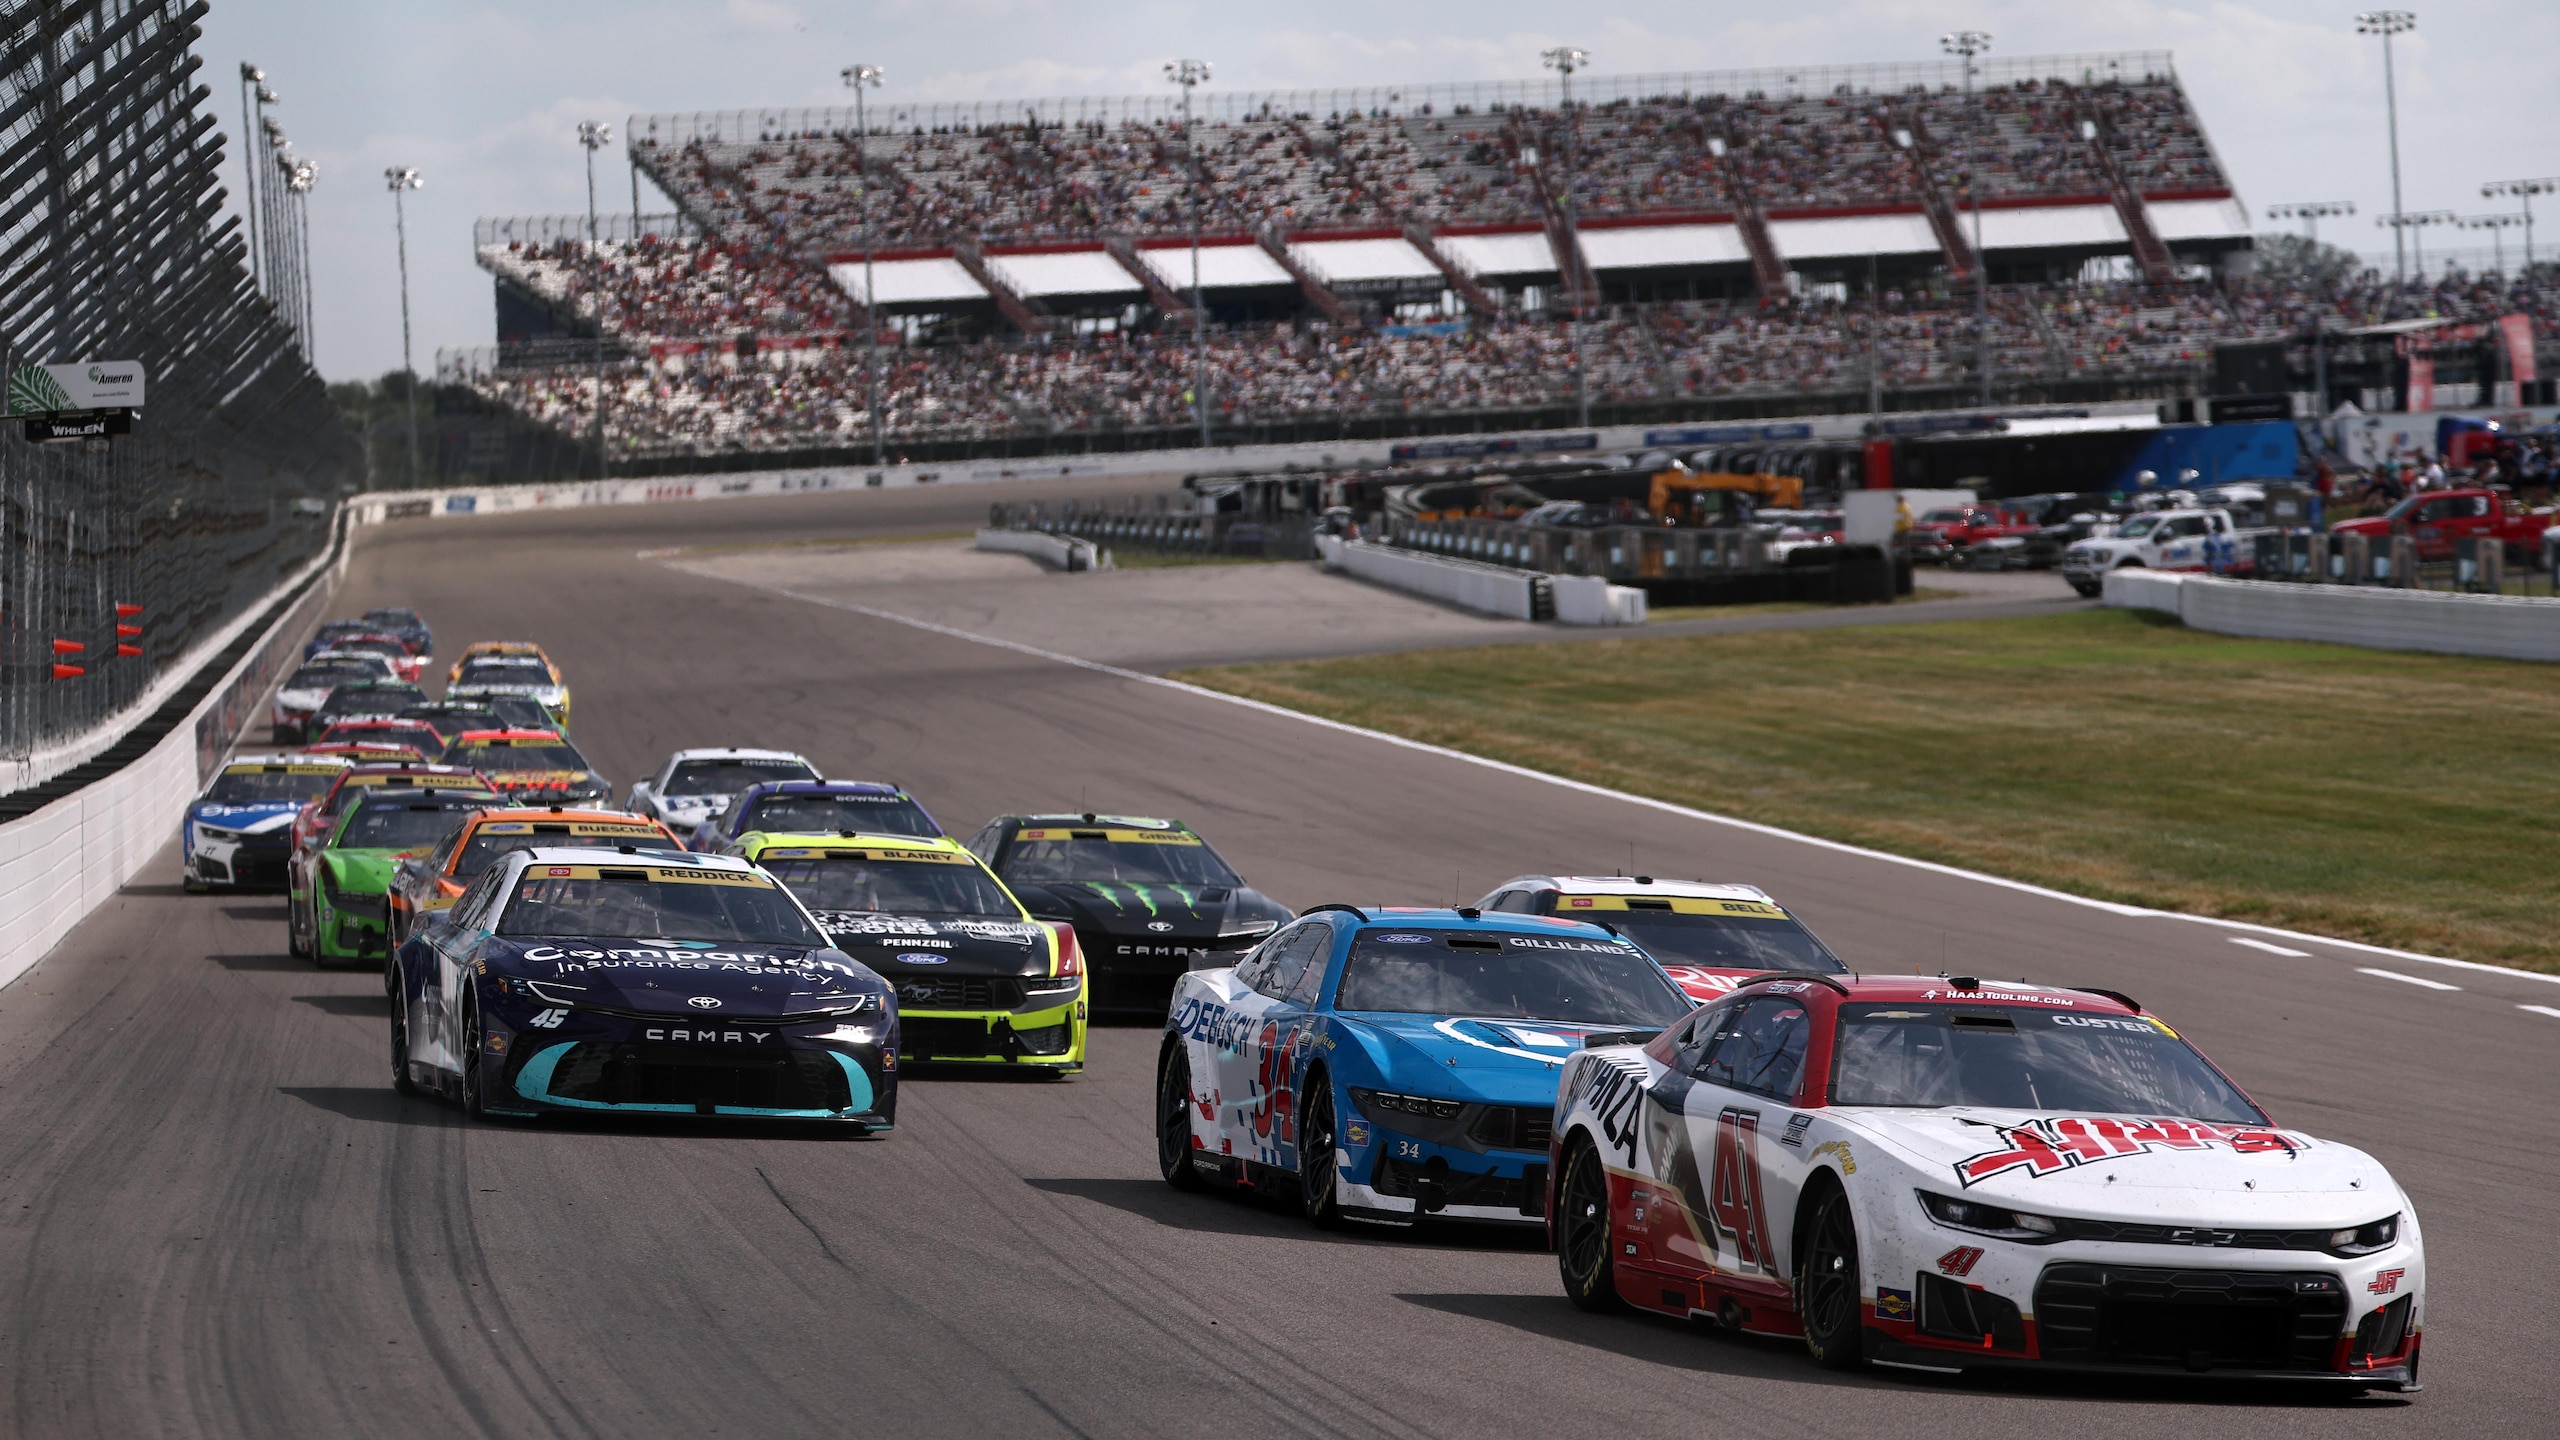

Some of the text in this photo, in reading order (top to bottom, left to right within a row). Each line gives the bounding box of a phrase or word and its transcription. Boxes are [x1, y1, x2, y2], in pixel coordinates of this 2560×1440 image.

[99, 373, 133, 385] Ameren
[835, 795, 899, 804] BOWMAN
[1138, 832, 1189, 842] GIBBS
[204, 847, 216, 855] 77
[883, 851, 952, 861] BLANEY
[659, 868, 753, 883] REDDICK
[1720, 903, 1773, 914] BELL
[883, 938, 952, 949] PENNZOIL
[1387, 934, 1424, 943] Ford
[1509, 937, 1624, 955] GILLILAND
[1117, 945, 1209, 958] CAMRY
[523, 947, 856, 978] Comparion
[557, 961, 834, 985] Insurance Agency
[529, 1008, 569, 1028] 45
[2052, 1014, 2158, 1034] CUSTER
[646, 1028, 772, 1044] CAMRY
[1254, 1019, 1301, 1148] 34
[1400, 1141, 1420, 1159] 34
[1709, 1104, 1781, 1278] 41
[1936, 1246, 1985, 1276] 41
[1879, 1299, 1909, 1310] SUNOCO
